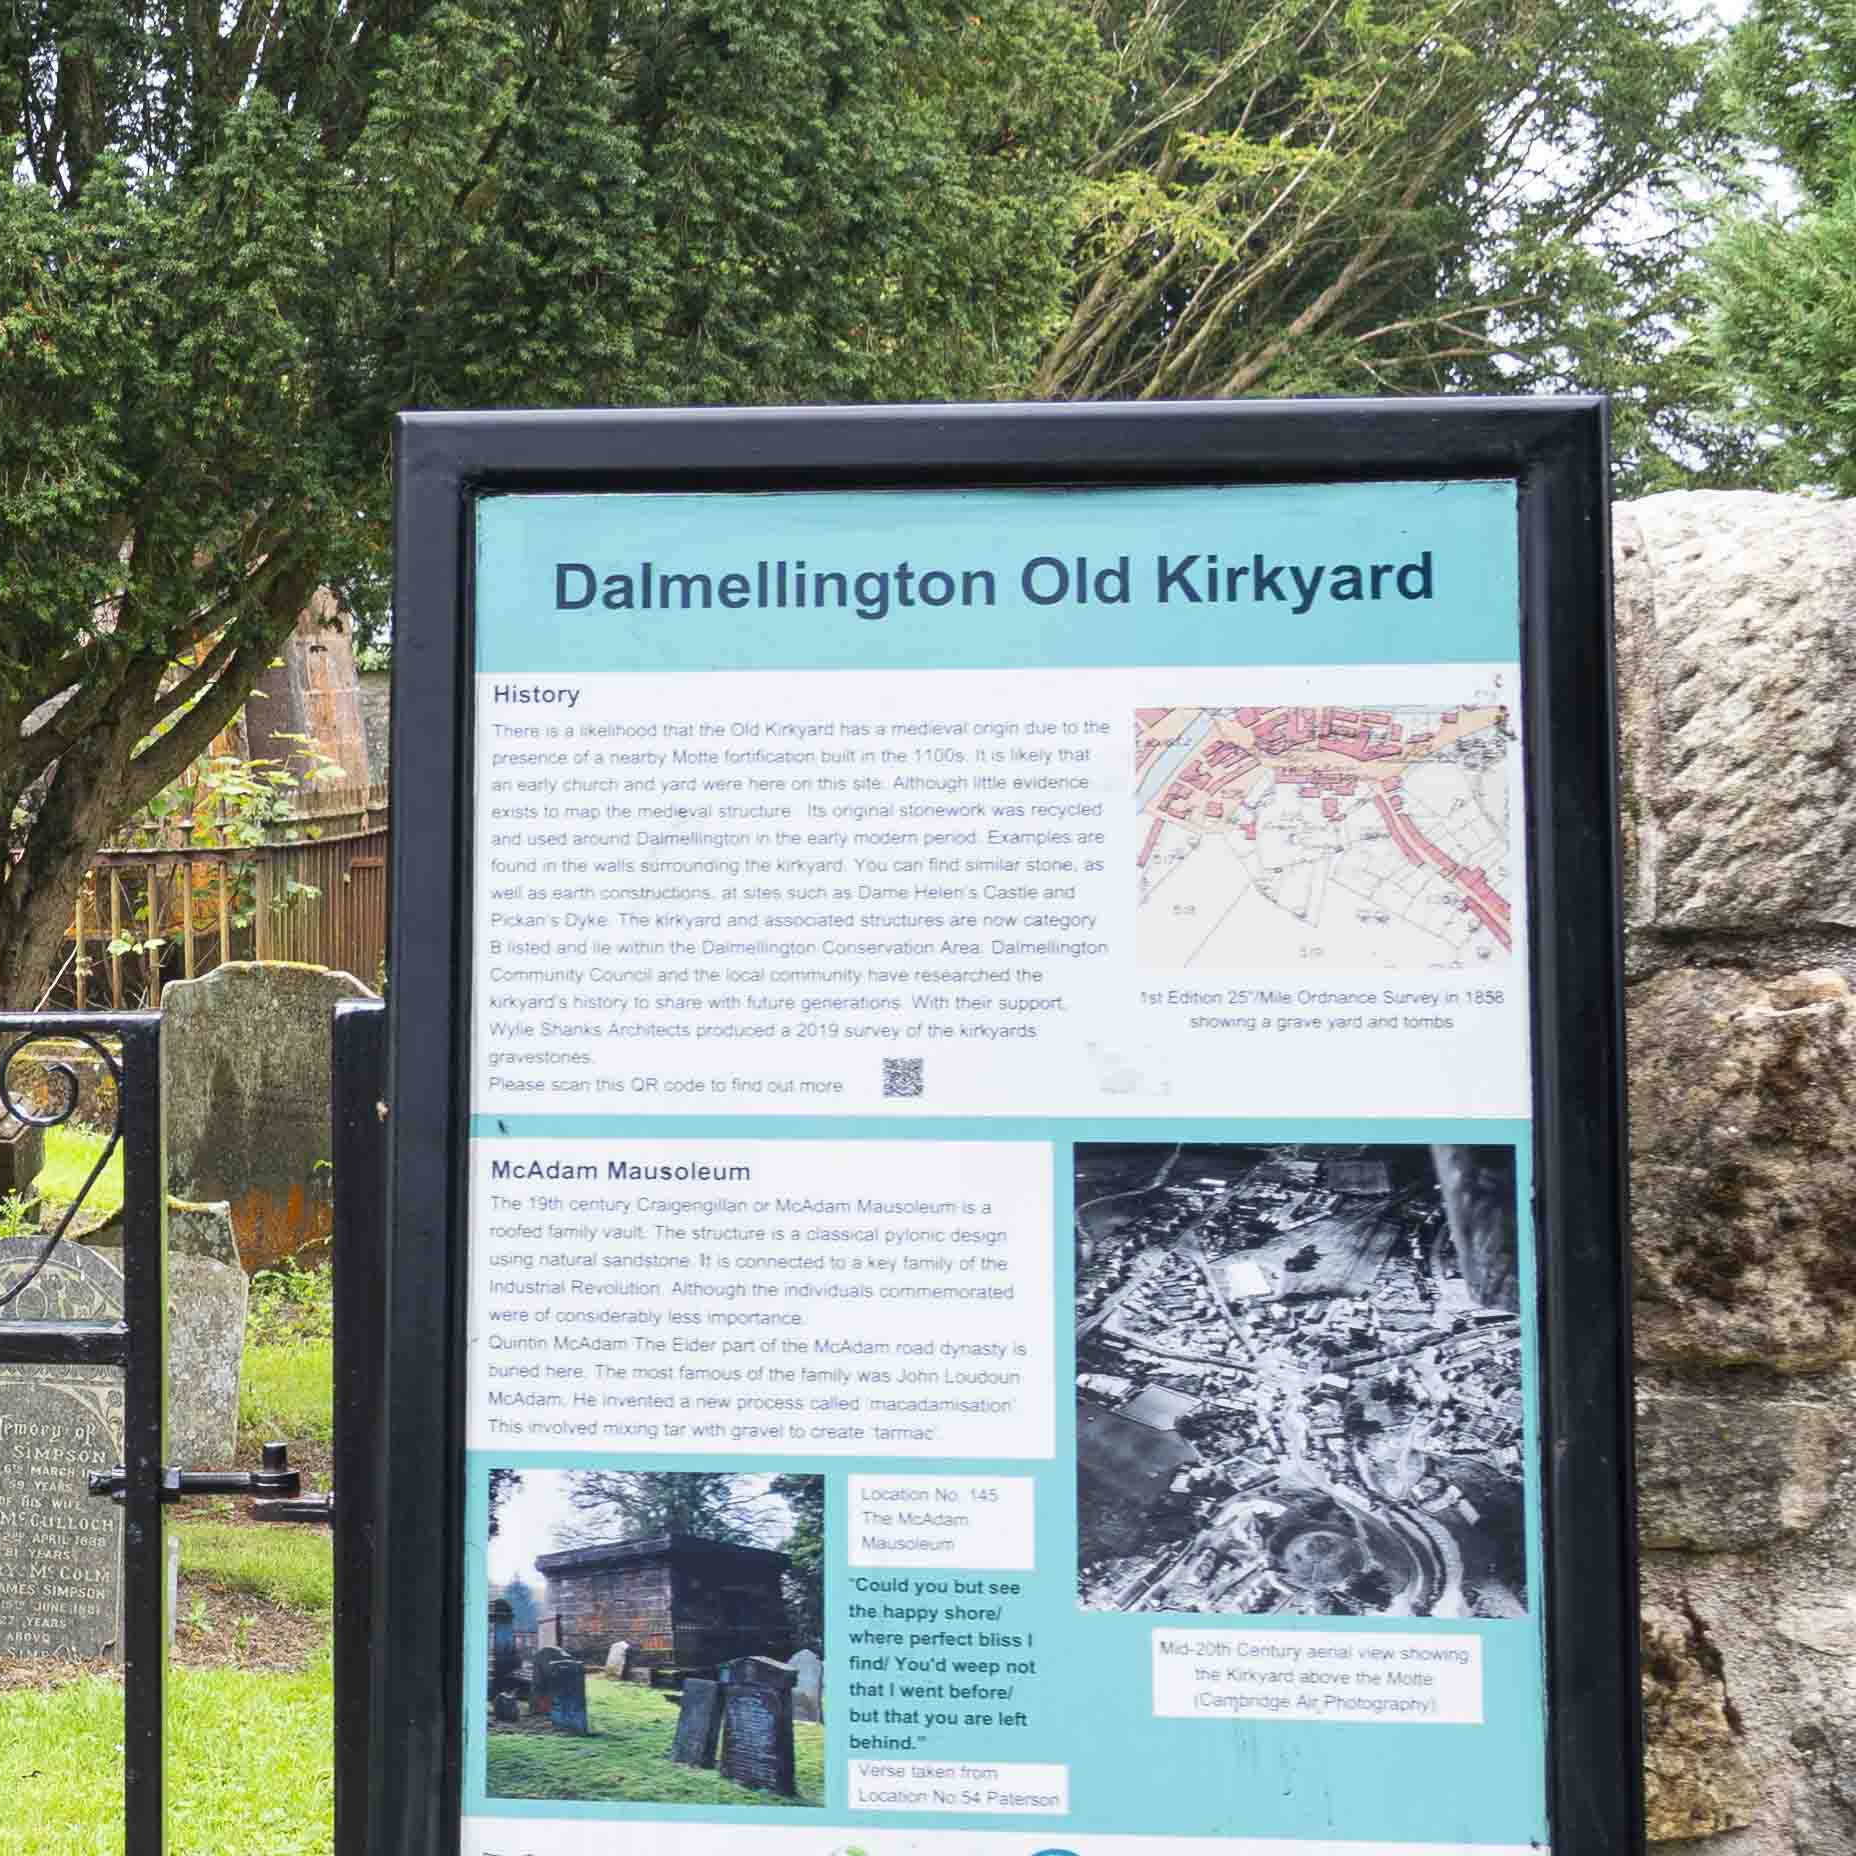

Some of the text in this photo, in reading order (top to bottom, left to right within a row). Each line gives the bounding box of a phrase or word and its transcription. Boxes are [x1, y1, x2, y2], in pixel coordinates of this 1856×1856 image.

[556, 551, 1432, 620] Dalmellington Old Kirkyard
[495, 684, 579, 708] History
[492, 719, 1110, 741] There is a likelihood that the Old Kirkyard has a medieval origin due to the
[1141, 992, 1163, 1005] 1st
[1168, 990, 1222, 1005] Edition
[1298, 989, 1376, 1005] Ordnance
[1384, 990, 1439, 1007] Survey
[1445, 992, 1459, 1003] in
[1190, 1016, 1454, 1032] showing a grave yard and tombs
[492, 1159, 749, 1181] McAdam Mausoleum
[490, 1191, 522, 1211] The
[530, 1196, 562, 1211] 19th
[569, 1199, 631, 1215] century
[754, 1201, 770, 1213] or
[776, 1197, 850, 1214] McAdam
[857, 1199, 958, 1214] Mausoleum
[962, 1203, 976, 1214] is
[981, 1204, 992, 1216] a
[30, 1465, 76, 1478] MARCH
[34, 1480, 72, 1492] YEARS
[862, 1487, 928, 1502] Location
[971, 1488, 998, 1502] 145
[862, 1511, 968, 1527] The McAdam
[32, 1533, 68, 1545] APRIL
[862, 1535, 954, 1551] Mausoleum
[43, 1584, 105, 1599] SIMPSON
[915, 1582, 948, 1597] you
[954, 1580, 984, 1594] but
[989, 1583, 1020, 1595] see
[849, 1603, 1001, 1623] the happy shore/
[849, 1629, 1032, 1648] where perfect bliss I
[1160, 1640, 1468, 1665] Mid-20th Century aerial view showing
[849, 1656, 1036, 1677] find/ You'd weep not
[1195, 1668, 1432, 1686] the Kirkyard above the Motte
[850, 1681, 1013, 1700] that I went before/
[850, 1708, 1027, 1728] but that you are left
[850, 1734, 926, 1750] behind."
[858, 1764, 999, 1781] Verse taken from
[858, 1790, 928, 1804] Location
[961, 1791, 981, 1805] 54
[987, 1792, 1060, 1807] Paterson
